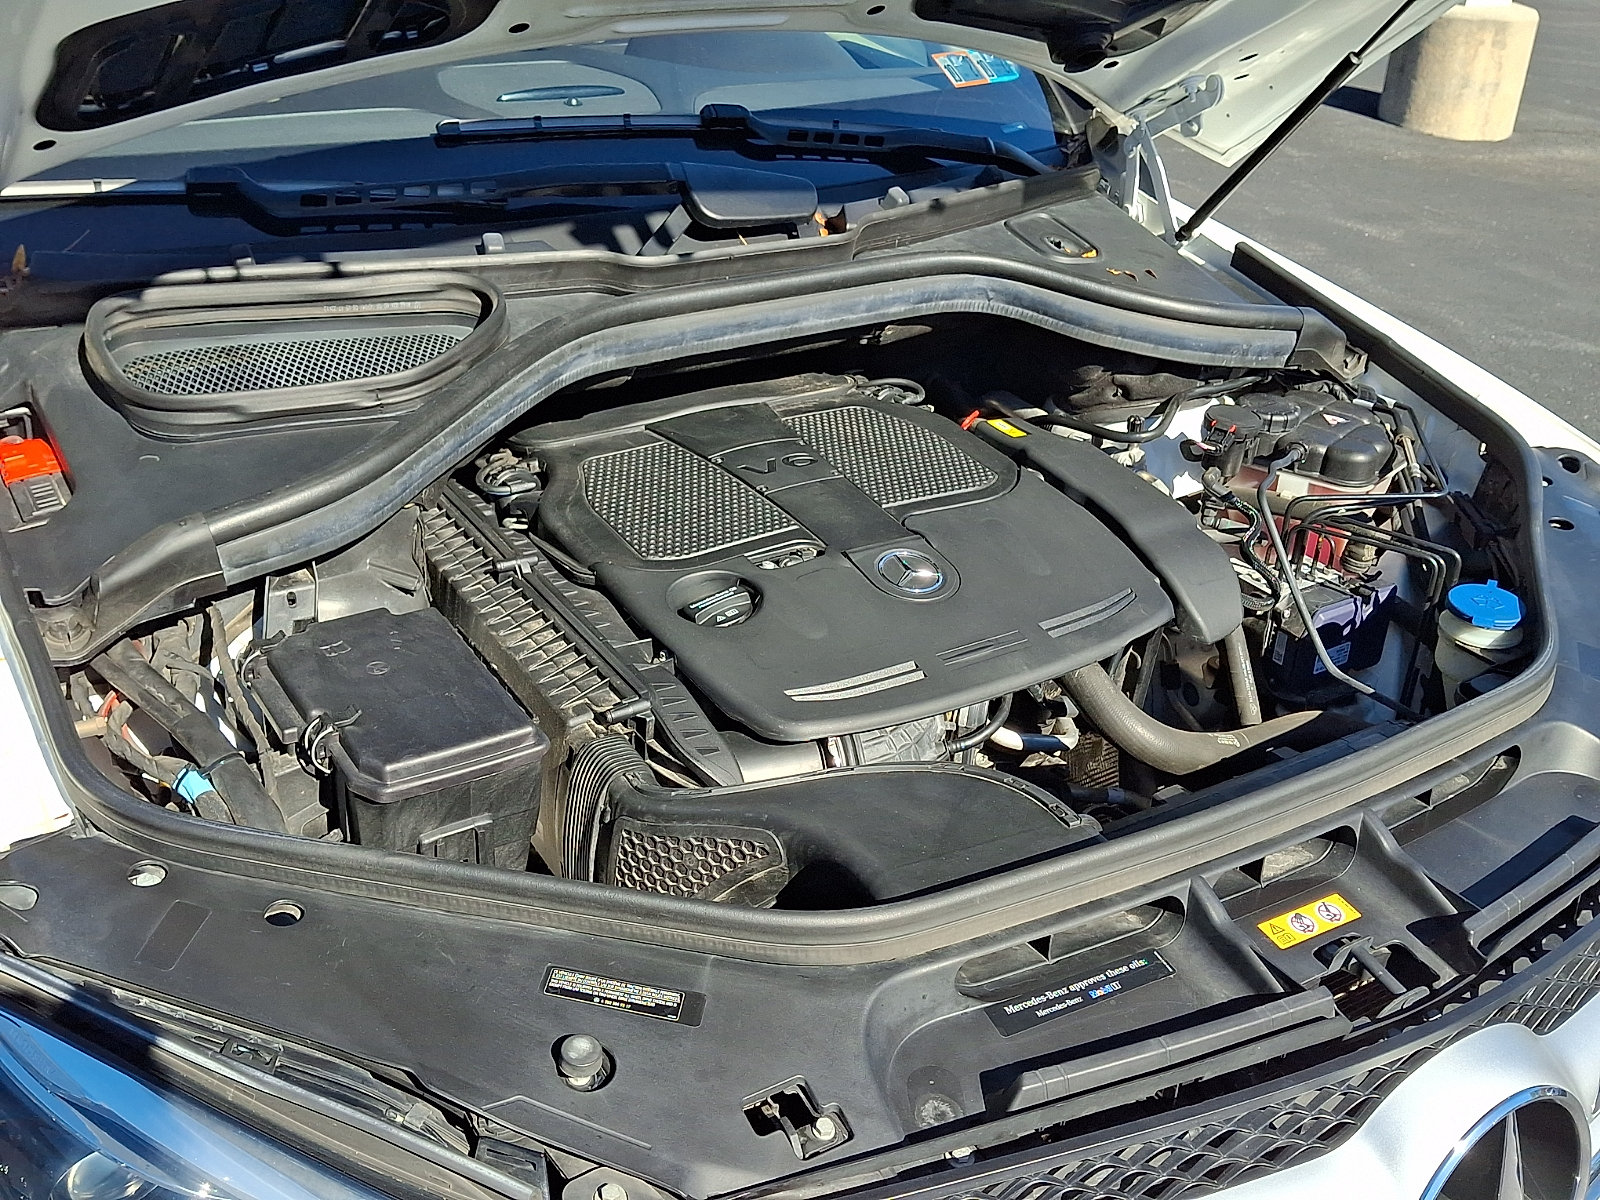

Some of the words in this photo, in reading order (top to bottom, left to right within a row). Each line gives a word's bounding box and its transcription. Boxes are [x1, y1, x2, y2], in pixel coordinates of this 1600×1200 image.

[736, 452, 818, 475] V6
[1003, 986, 1069, 1015] Mercedes-Benz
[1069, 973, 1106, 993] approves
[1106, 964, 1129, 978] these
